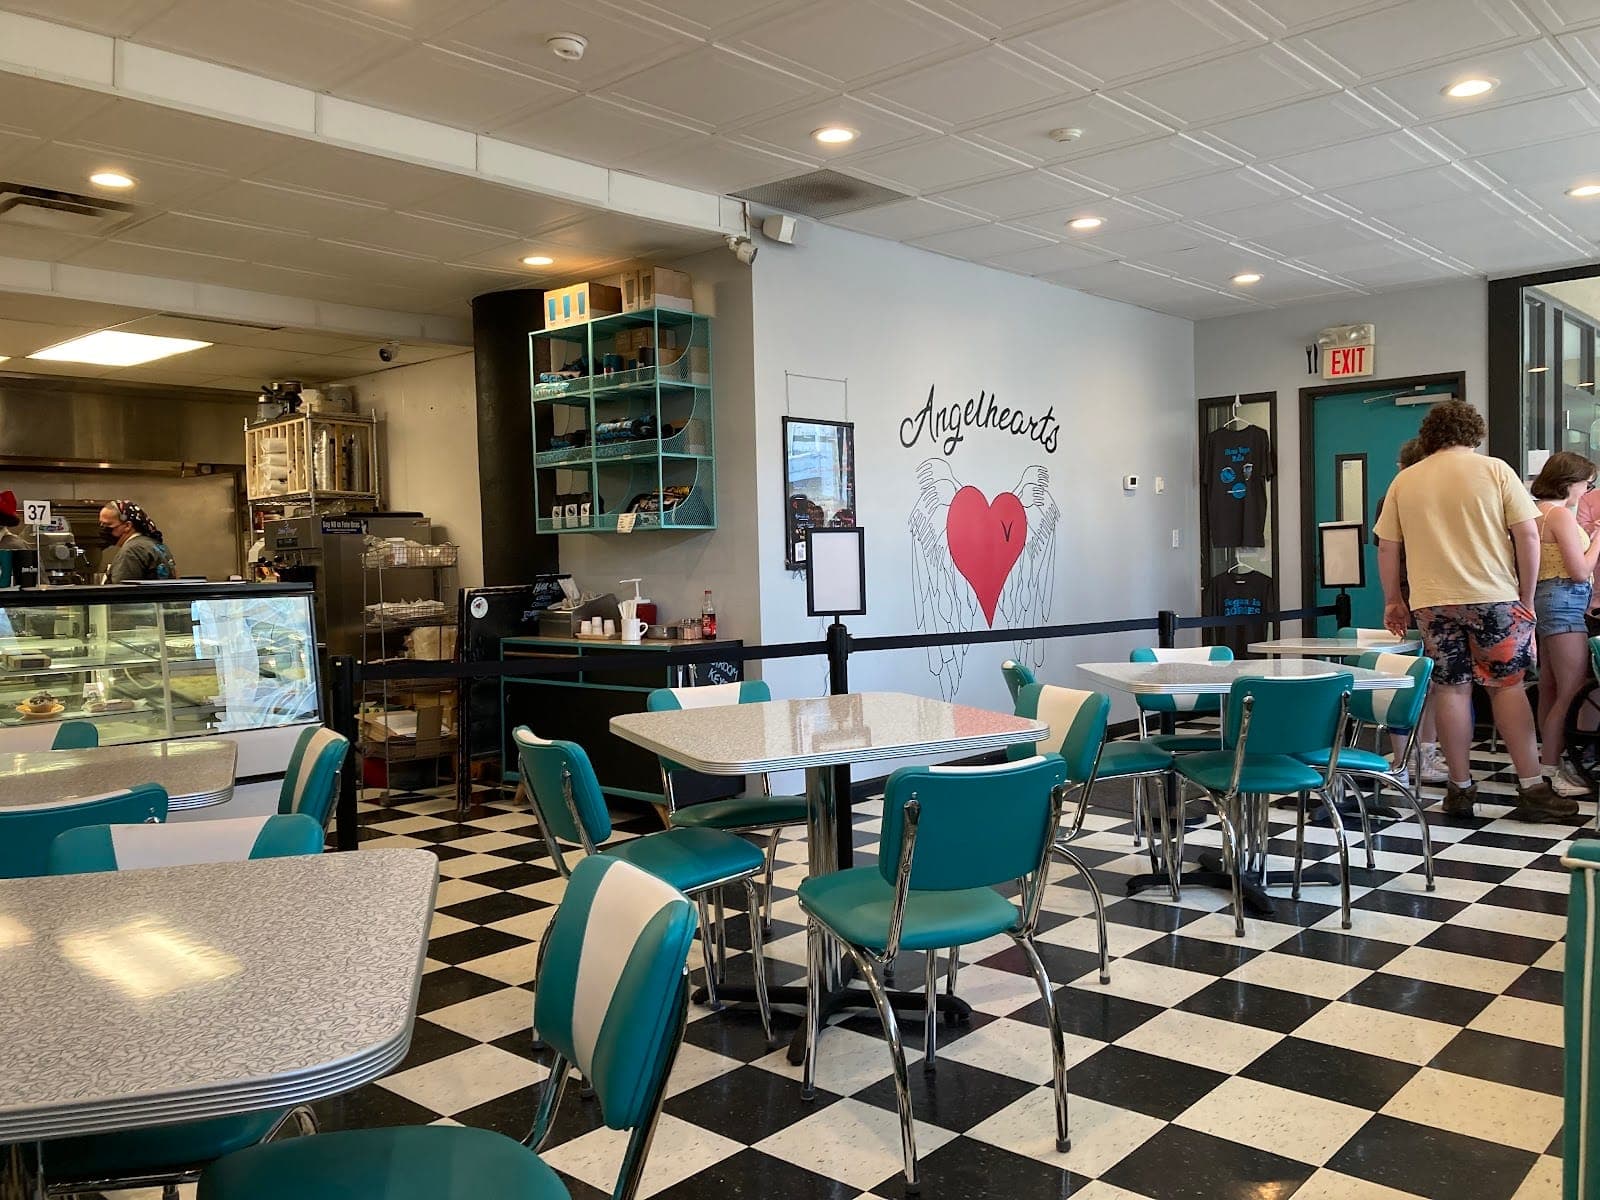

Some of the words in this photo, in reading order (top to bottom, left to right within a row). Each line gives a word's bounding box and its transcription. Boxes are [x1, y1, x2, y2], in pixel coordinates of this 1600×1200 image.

[1332, 347, 1366, 375] EXIT
[899, 383, 1061, 456] Angelhearts
[28, 504, 47, 520] 37
